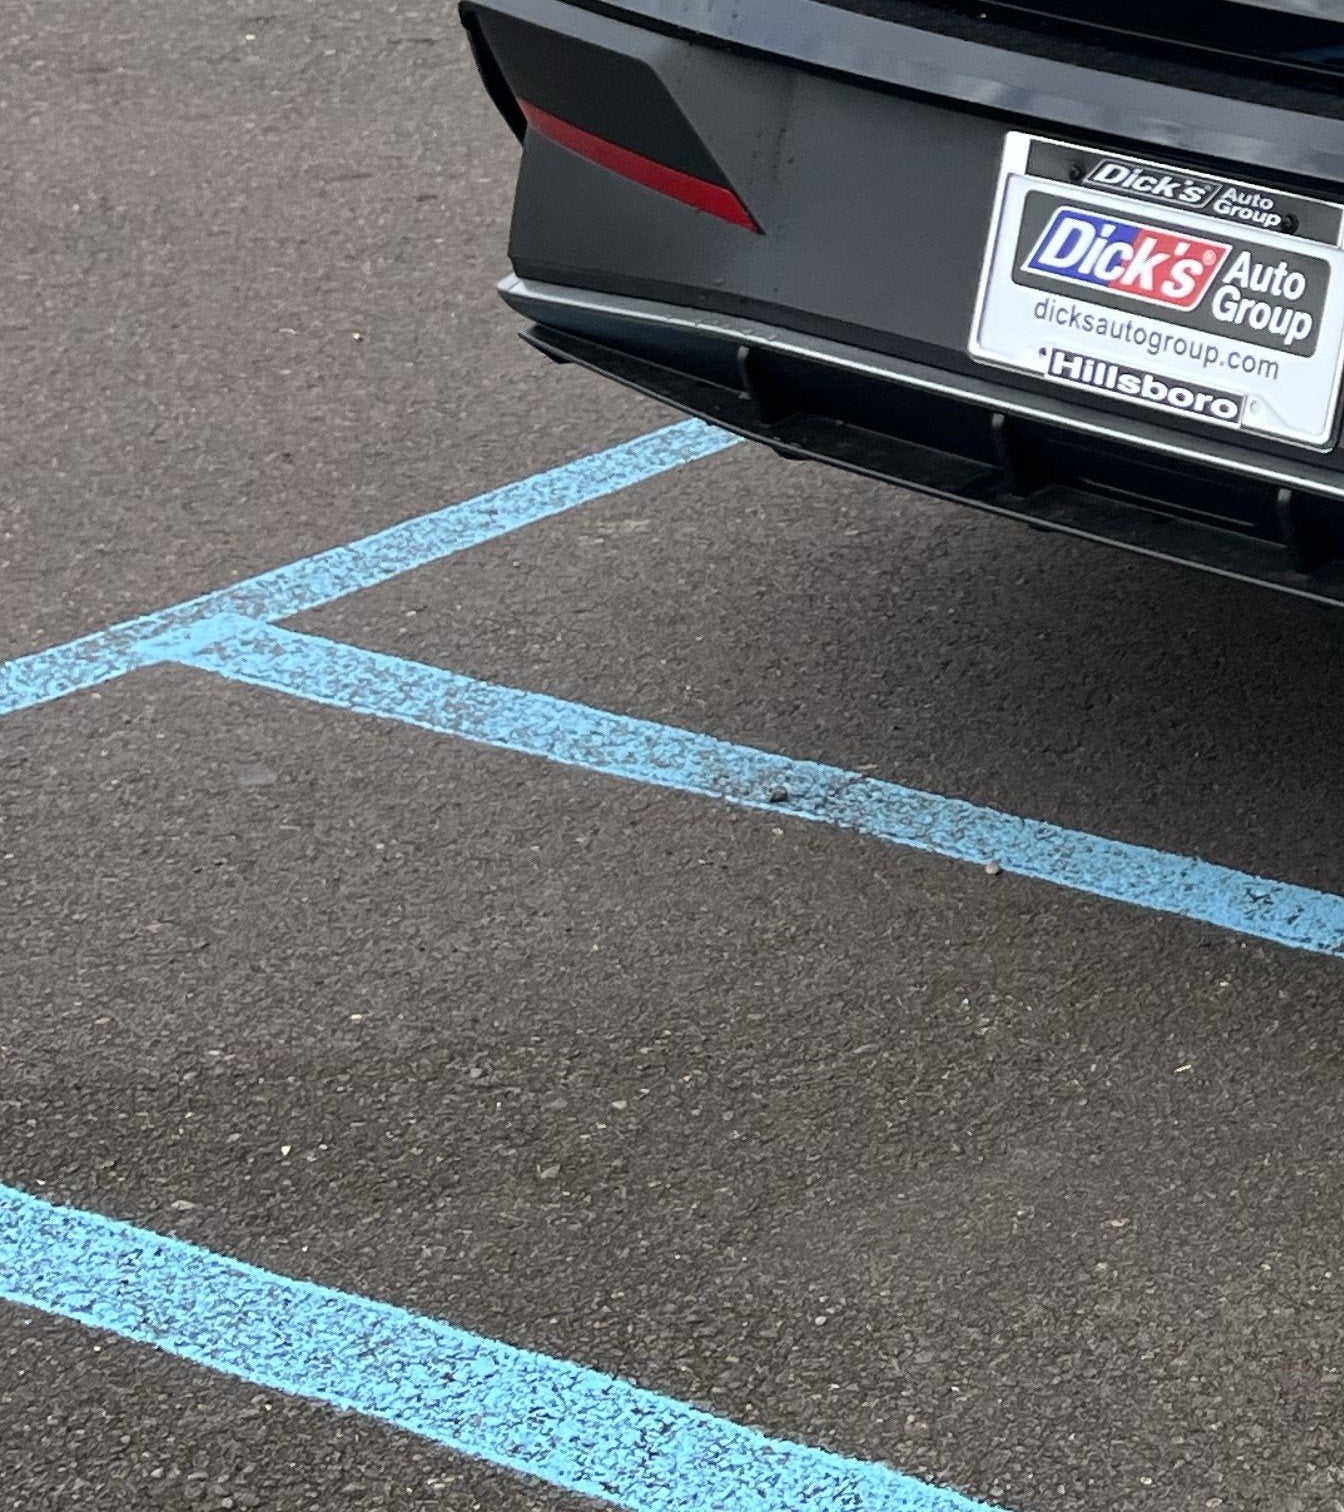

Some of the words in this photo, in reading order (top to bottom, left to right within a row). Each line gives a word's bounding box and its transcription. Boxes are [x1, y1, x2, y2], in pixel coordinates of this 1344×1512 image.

[1092, 162, 1207, 204] Dick's
[1220, 187, 1275, 211] Auto
[1212, 199, 1283, 229] Group
[1038, 217, 1204, 299] Dick's
[1223, 251, 1306, 299] Auto
[1033, 298, 1281, 380] dicksautogroup.com
[1211, 286, 1313, 347] Group
[1051, 348, 1240, 421] Hillsboro
